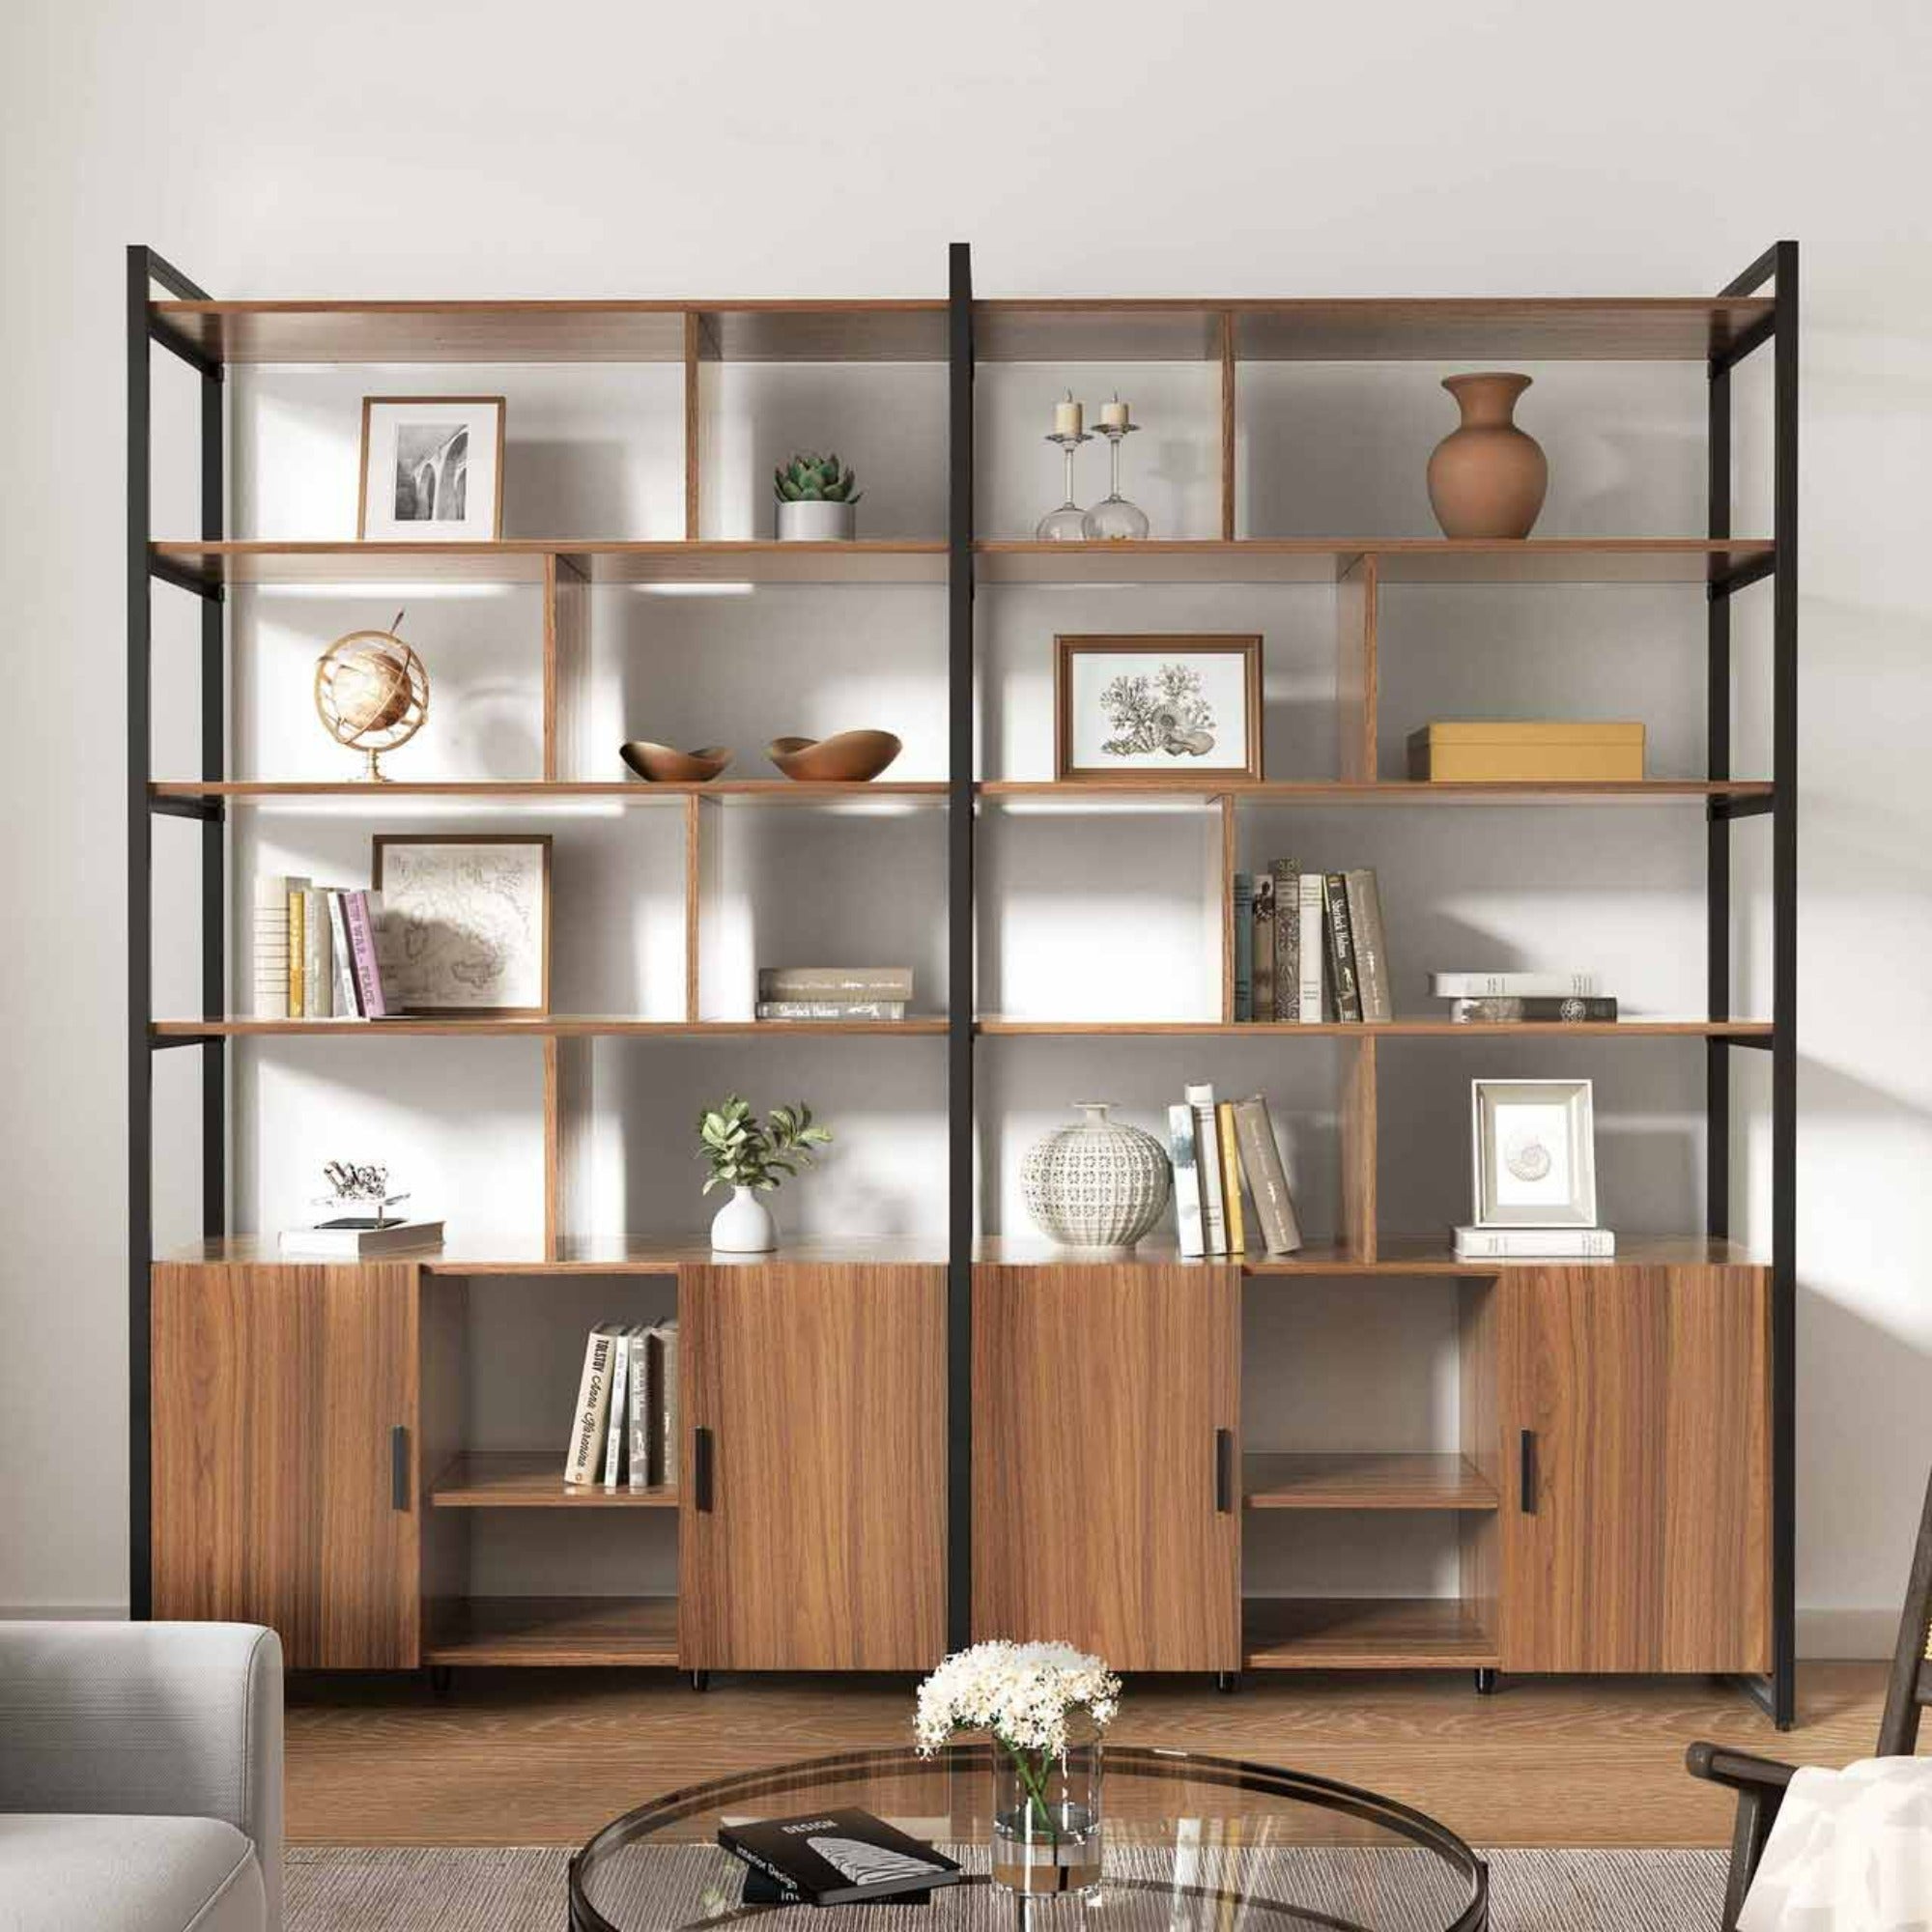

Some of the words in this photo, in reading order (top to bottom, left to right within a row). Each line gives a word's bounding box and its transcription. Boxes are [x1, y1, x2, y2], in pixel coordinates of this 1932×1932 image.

[591, 1339, 609, 1373] TOLSTOY
[587, 1375, 601, 1408] Anna
[577, 1411, 595, 1468] Karenina
[781, 1819, 838, 1834] DESIGN
